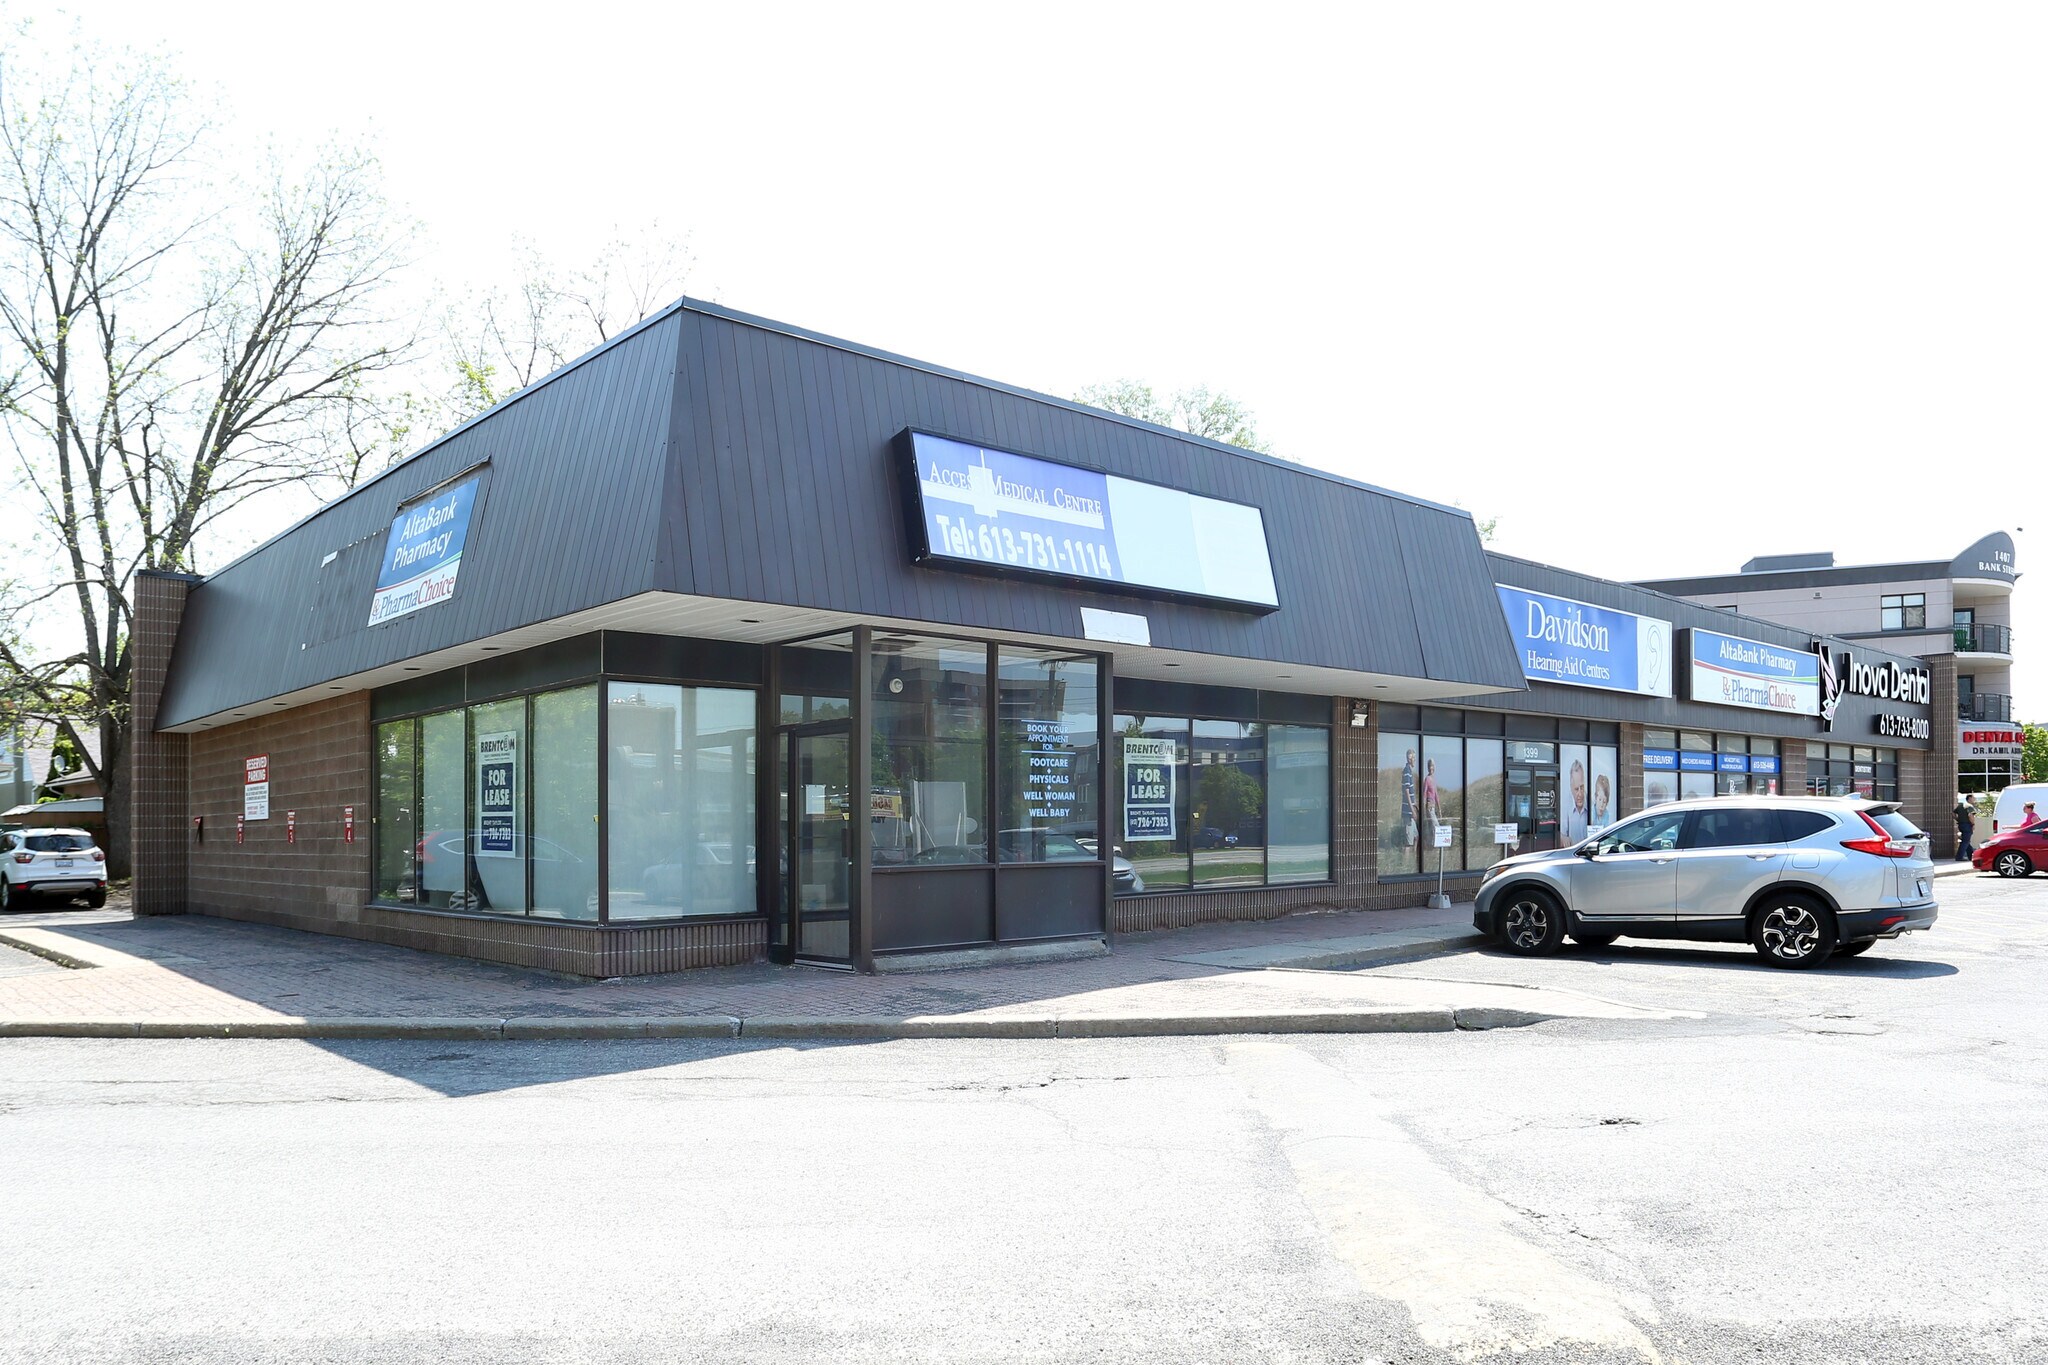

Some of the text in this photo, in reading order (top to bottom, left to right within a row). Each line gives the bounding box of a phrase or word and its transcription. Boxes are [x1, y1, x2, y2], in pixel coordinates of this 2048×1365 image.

[929, 461, 973, 490] ACCES
[1053, 487, 1103, 515] CENTRE
[400, 495, 457, 542] AltaBank
[392, 531, 452, 572] Pharmacy
[935, 514, 1112, 577] Tel: 613-731-1114
[1978, 562, 2001, 572] BANK
[379, 575, 455, 619] PharmaChoice
[1526, 599, 1609, 652] Davidson
[1527, 649, 1610, 680] Hearing Aid Centres
[1719, 640, 1797, 677] AltaBank Pharmacy
[1849, 652, 1930, 705] Inova Dental
[1732, 679, 1797, 709] PharmaChoice
[1027, 724, 1069, 733] BOOK YOUR
[1880, 713, 1929, 739] 613-733-8000
[1027, 734, 1069, 743] APPOINTMENT
[1963, 731, 2015, 743] DENTAL
[1030, 758, 1069, 767] FOOTCARE
[1643, 754, 1674, 765] FREE DELIVERY
[488, 769, 506, 786] FOR
[1029, 774, 1069, 784] PHYSICALS
[1137, 768, 1161, 783] FOR
[484, 788, 510, 806] LEASE
[1023, 791, 1075, 801] WELL WOMAN
[1131, 785, 1166, 799] LEASE
[1029, 808, 1070, 817] WELL BABY
